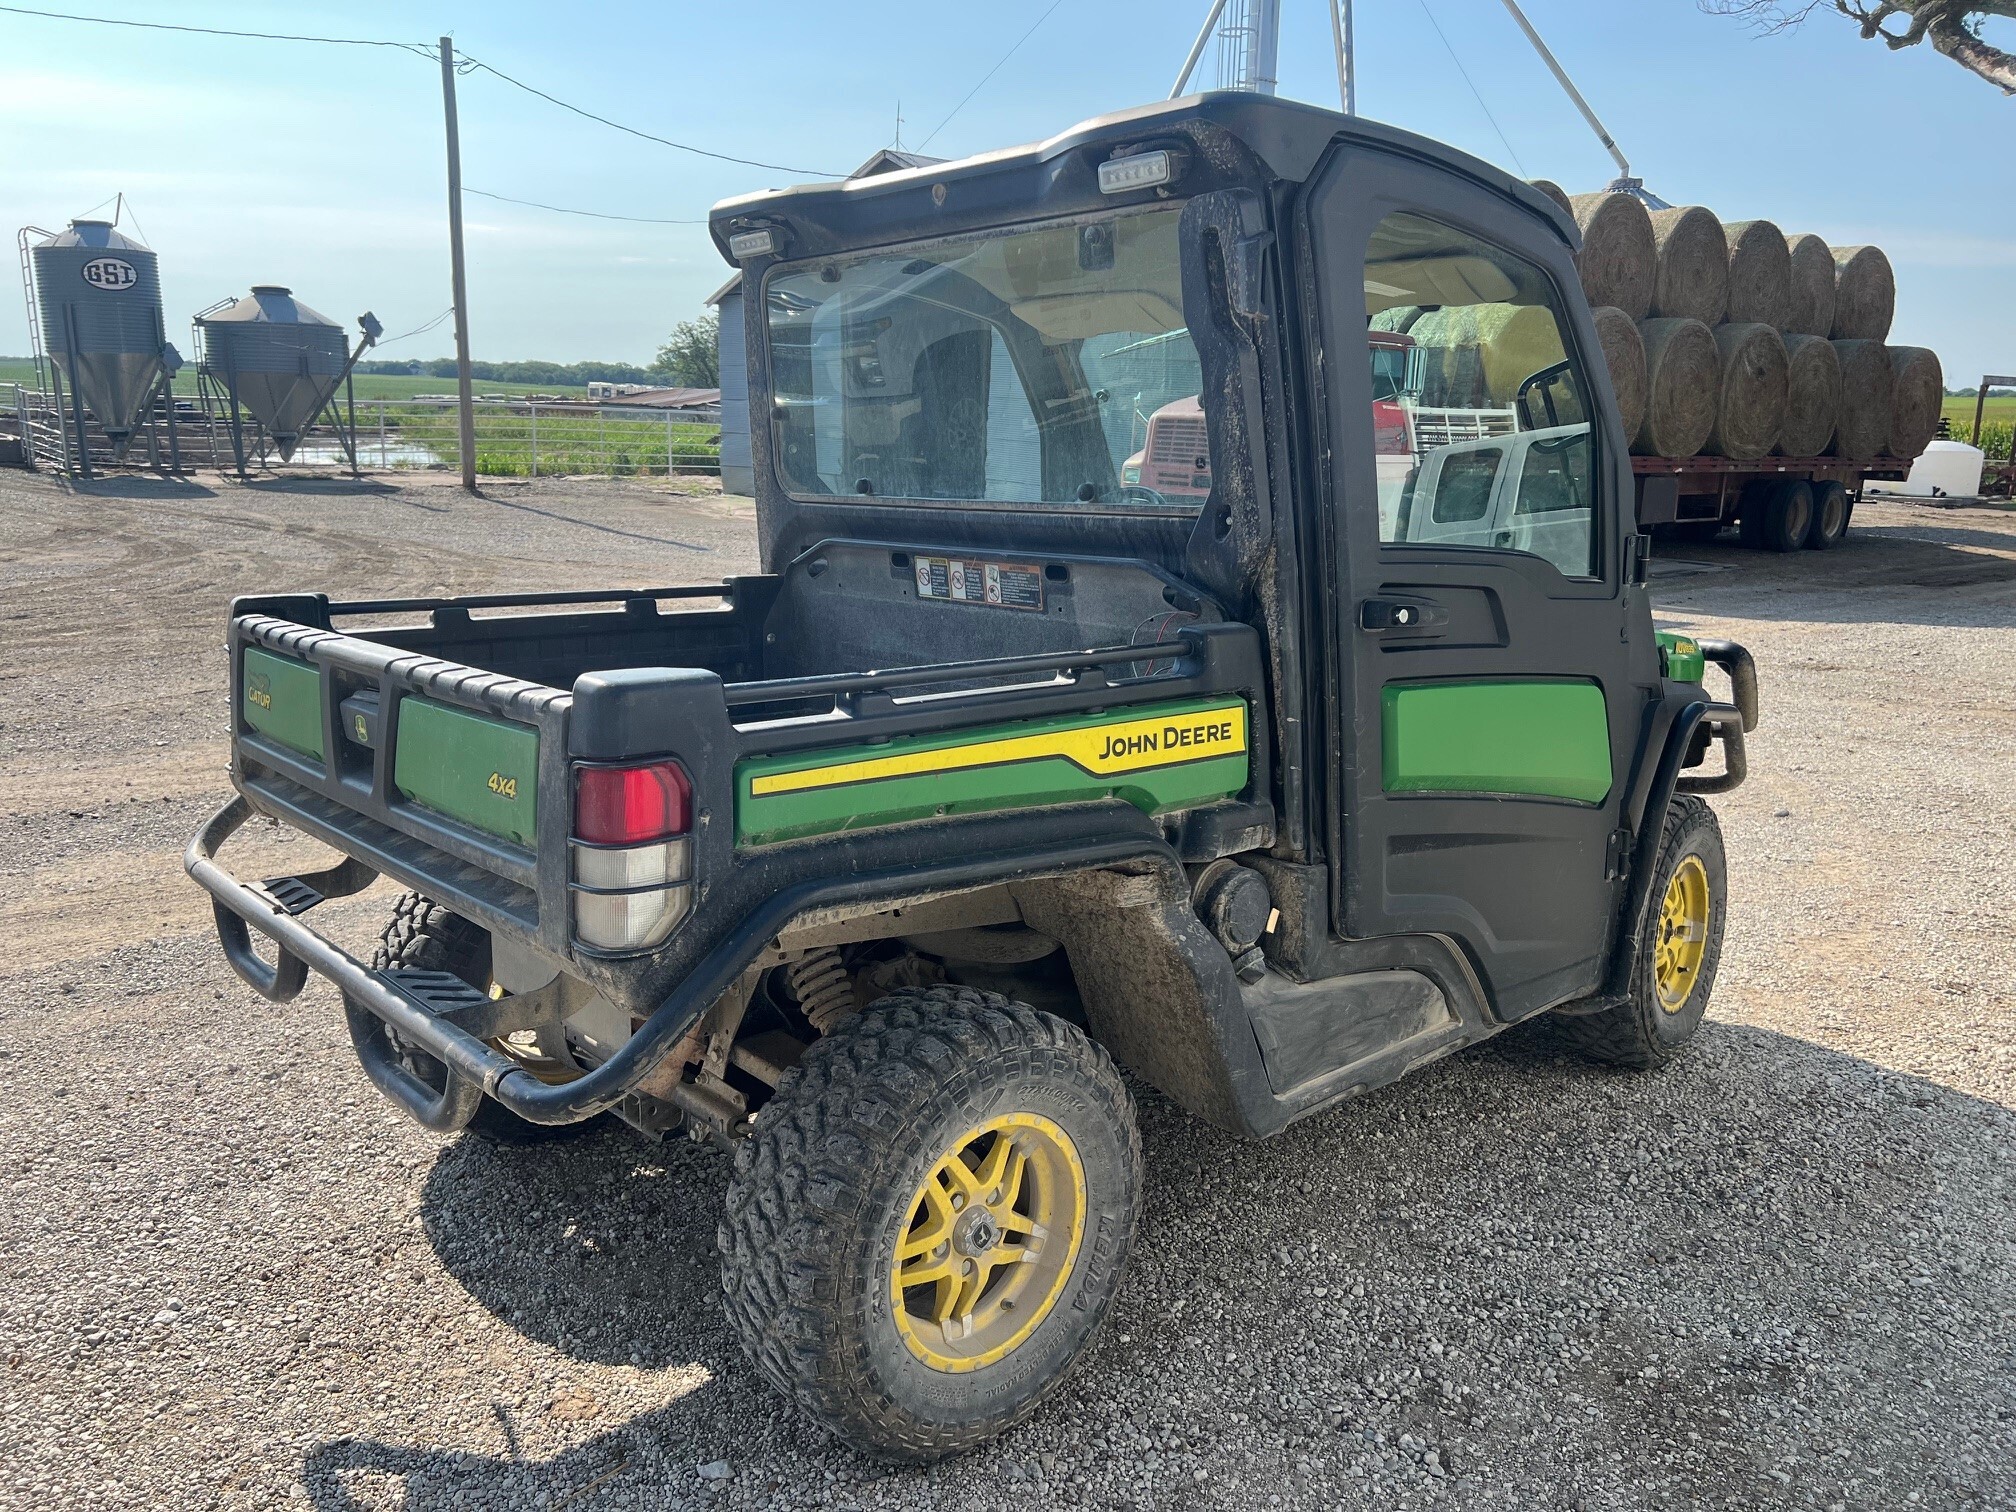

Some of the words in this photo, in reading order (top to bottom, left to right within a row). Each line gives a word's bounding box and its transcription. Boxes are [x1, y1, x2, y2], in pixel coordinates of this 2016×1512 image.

[87, 263, 134, 284] GSI
[248, 686, 271, 710] GATOR
[1099, 733, 1158, 760] JOHN
[1164, 722, 1232, 749] DEERE
[1072, 1214, 1115, 1312] KENDA
